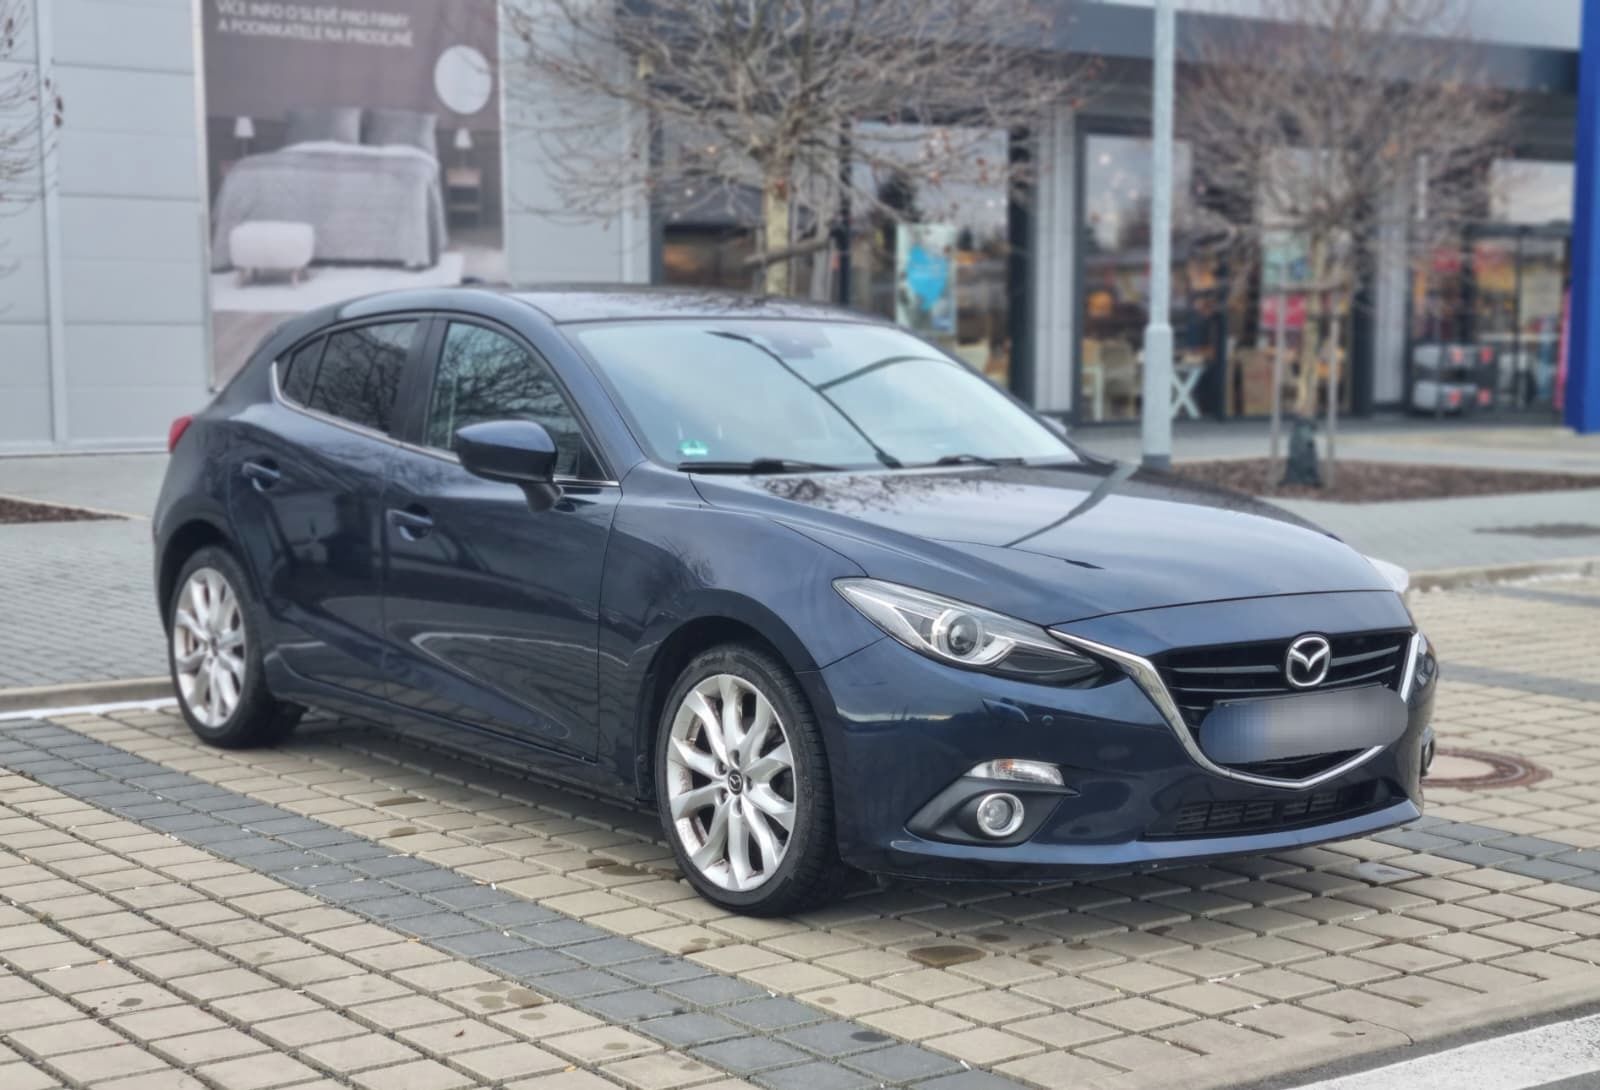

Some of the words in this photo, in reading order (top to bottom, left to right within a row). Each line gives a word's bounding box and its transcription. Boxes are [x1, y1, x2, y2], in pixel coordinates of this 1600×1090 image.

[250, 3, 284, 18] INFO
[286, 4, 298, 20] O
[340, 9, 368, 26] PRO
[217, 19, 229, 32] A
[325, 27, 343, 42] NA
